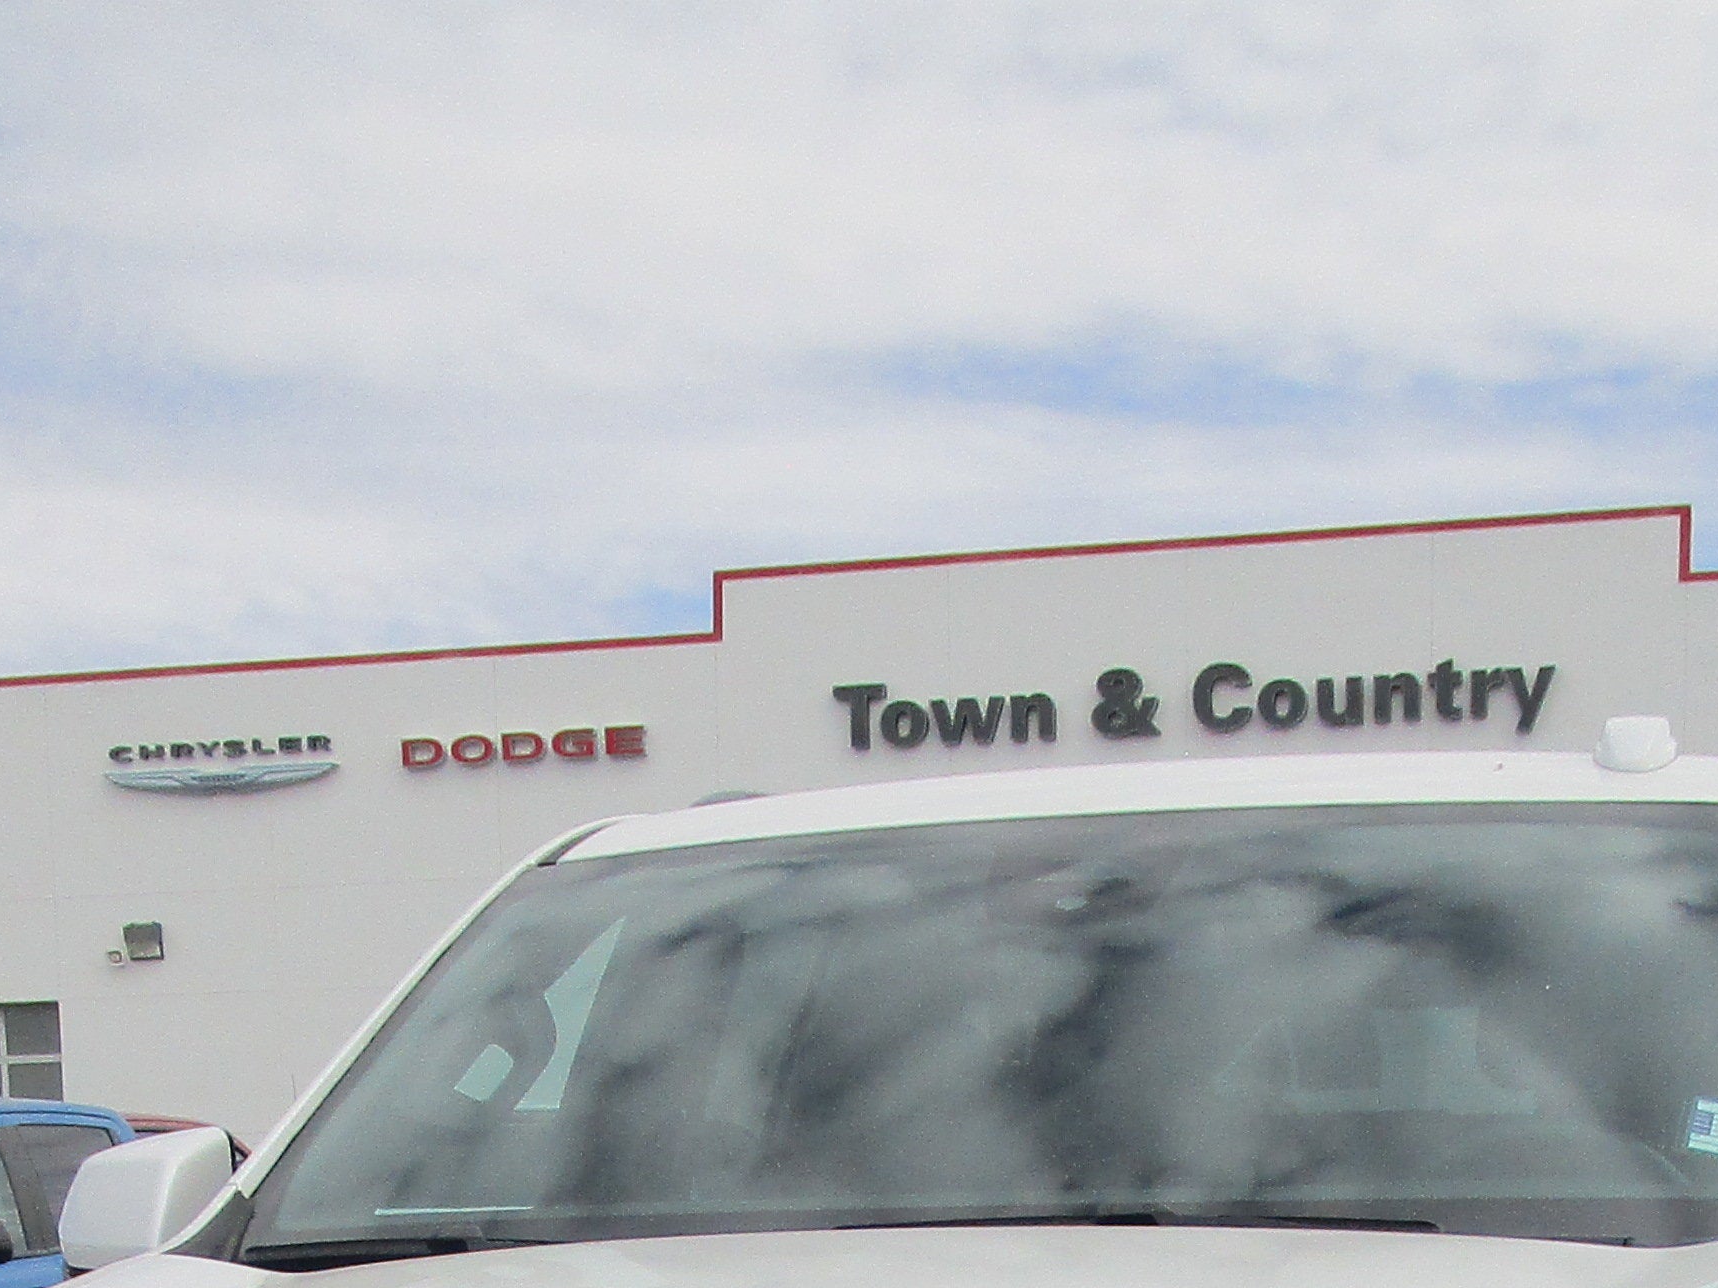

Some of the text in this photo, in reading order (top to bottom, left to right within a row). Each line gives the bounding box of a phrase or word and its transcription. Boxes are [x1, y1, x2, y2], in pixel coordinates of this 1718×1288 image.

[832, 660, 1556, 751] Town & Country
[108, 733, 333, 763] CHRYSLER
[400, 724, 646, 769] DODGE
